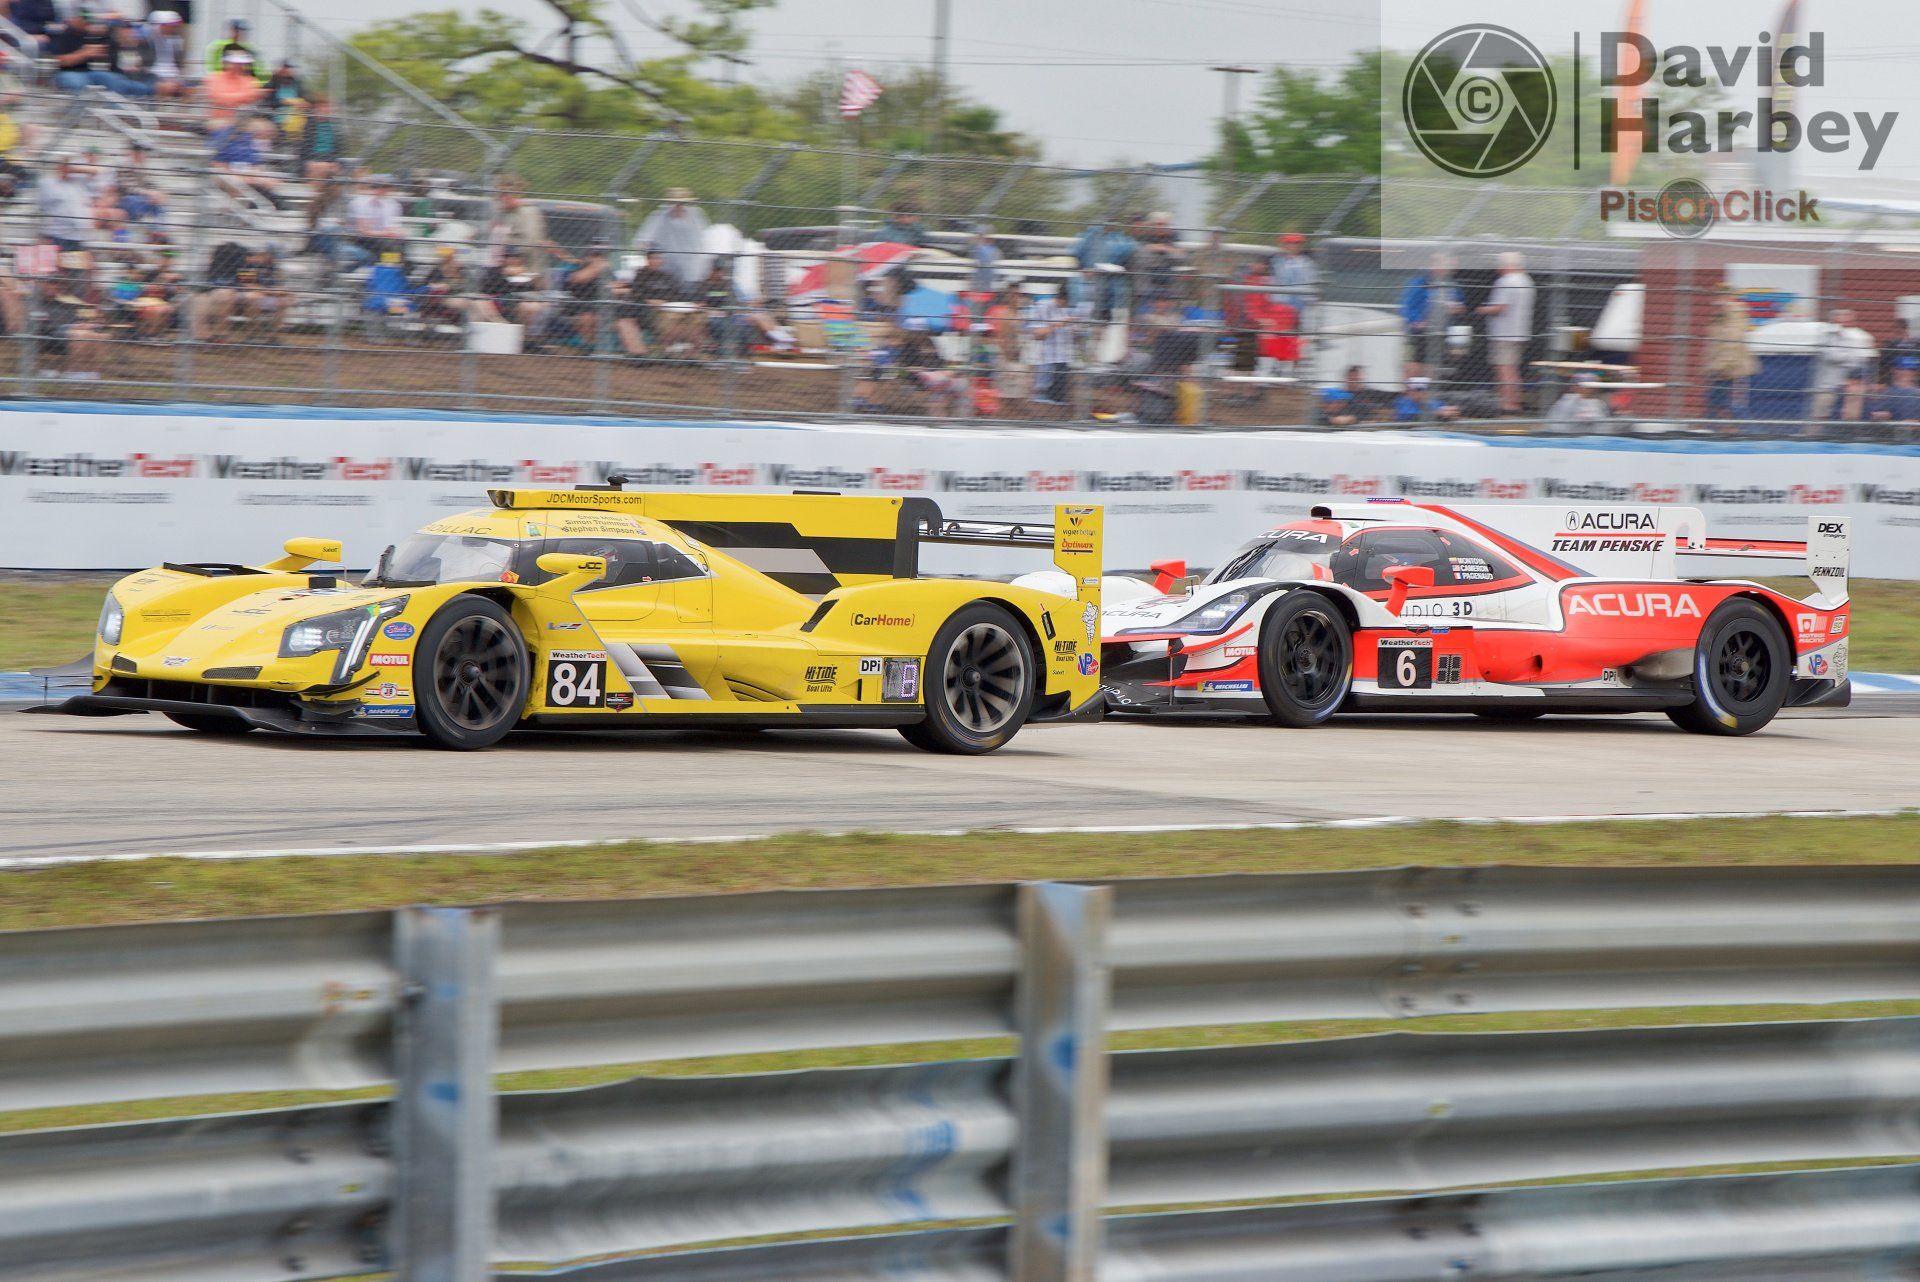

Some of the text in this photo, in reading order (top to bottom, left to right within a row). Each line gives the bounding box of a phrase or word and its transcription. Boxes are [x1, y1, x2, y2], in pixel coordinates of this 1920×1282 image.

[547, 493, 642, 506] JDCMotorSports.com
[1581, 513, 1655, 530] ACURA
[1817, 523, 1844, 534] DEX
[1551, 539, 1665, 552] TEAM PENSKE
[1811, 566, 1845, 578] PENNZOIL
[1569, 593, 1702, 618] ACURA
[1225, 647, 1256, 657] MOTUL
[371, 655, 409, 665] MOTUL
[861, 660, 880, 672] DPi
[1396, 649, 1417, 687] 6
[1603, 670, 1617, 682] DPi
[551, 662, 600, 706] 84
[806, 685, 833, 693] Boat Lifts
